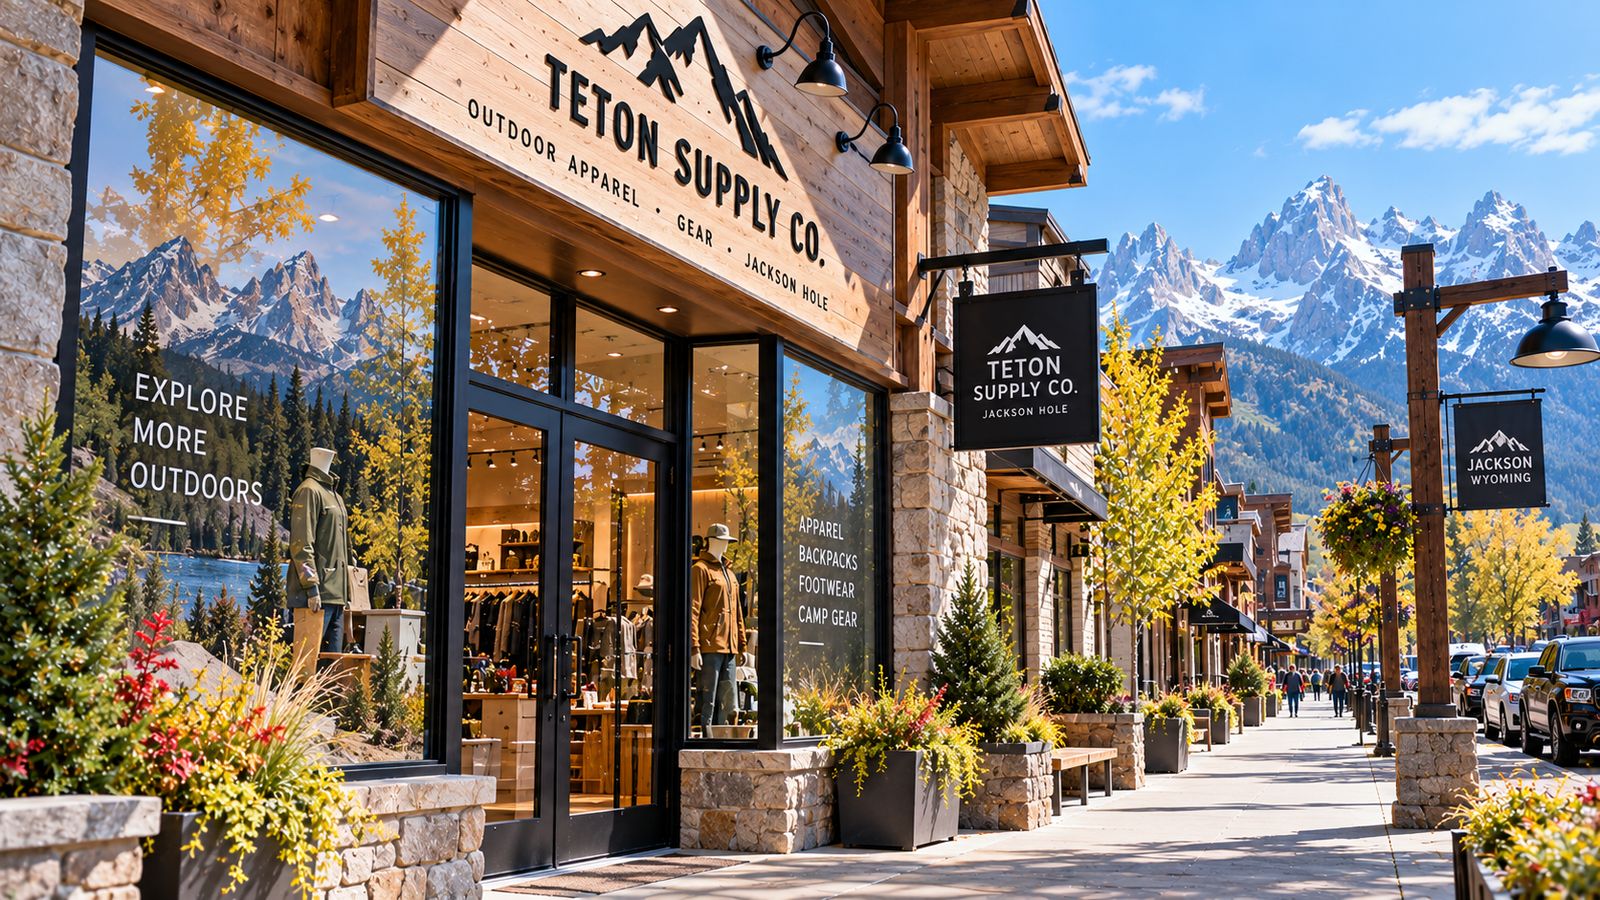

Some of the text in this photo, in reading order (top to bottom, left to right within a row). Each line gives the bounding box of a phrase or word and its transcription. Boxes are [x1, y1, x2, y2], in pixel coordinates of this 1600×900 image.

[545, 53, 825, 268] TETON SUPPLY CO.
[467, 98, 829, 312] OUTDOOR APPAREL GEAR JACKSON HOLE
[987, 355, 1061, 380] TETON
[135, 372, 248, 422] EXPLORE
[973, 378, 1078, 401] SUPPLY CO.
[982, 404, 1068, 419] JACKSON HOLE
[133, 416, 207, 456] MORE
[1467, 455, 1533, 472] JACKSON
[130, 461, 263, 507] OUTDOORS
[1470, 472, 1531, 485] WYOMING
[798, 514, 844, 541] APPAREL
[799, 544, 858, 571] BACKPACKS
[799, 574, 855, 599] FOOTWEAR
[798, 604, 858, 628] CAMP GEAR
